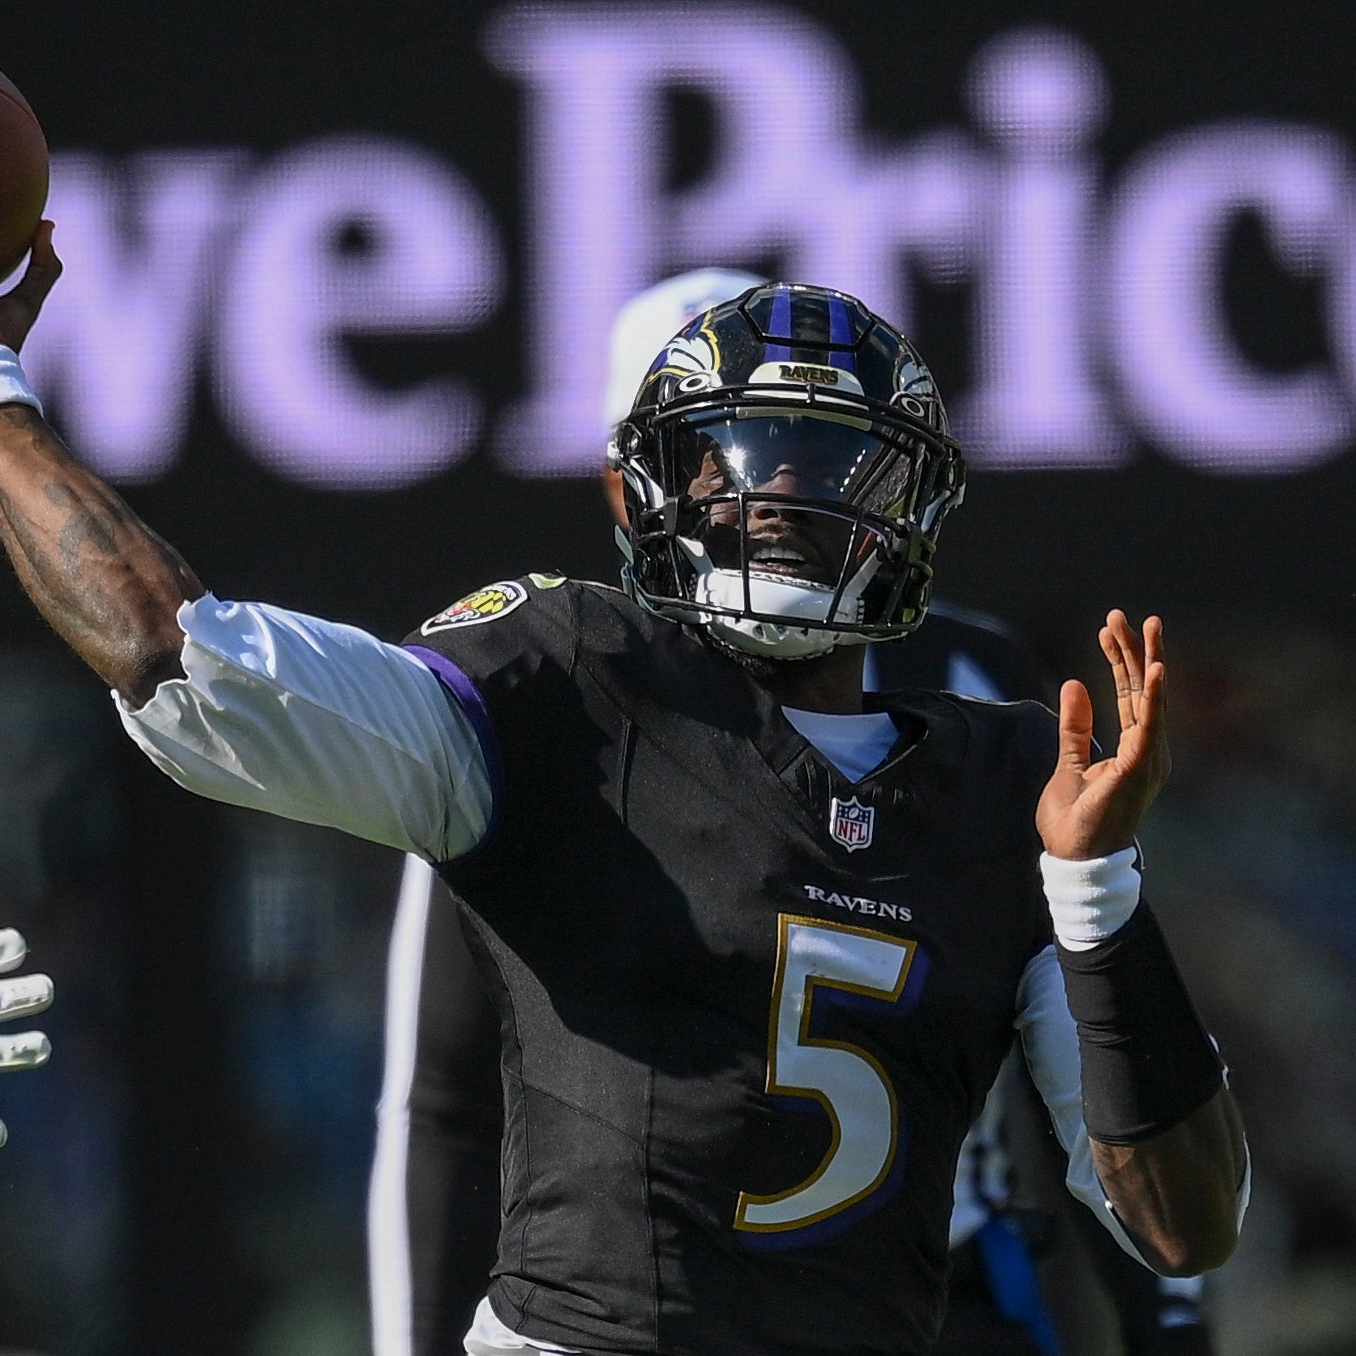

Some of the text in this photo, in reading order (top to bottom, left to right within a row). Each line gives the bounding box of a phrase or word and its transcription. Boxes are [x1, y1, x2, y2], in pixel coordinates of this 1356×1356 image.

[779, 365, 839, 385] RAVENS
[838, 819, 866, 842] NFL
[804, 885, 913, 922] RAVENS
[733, 912, 923, 1237] 5
